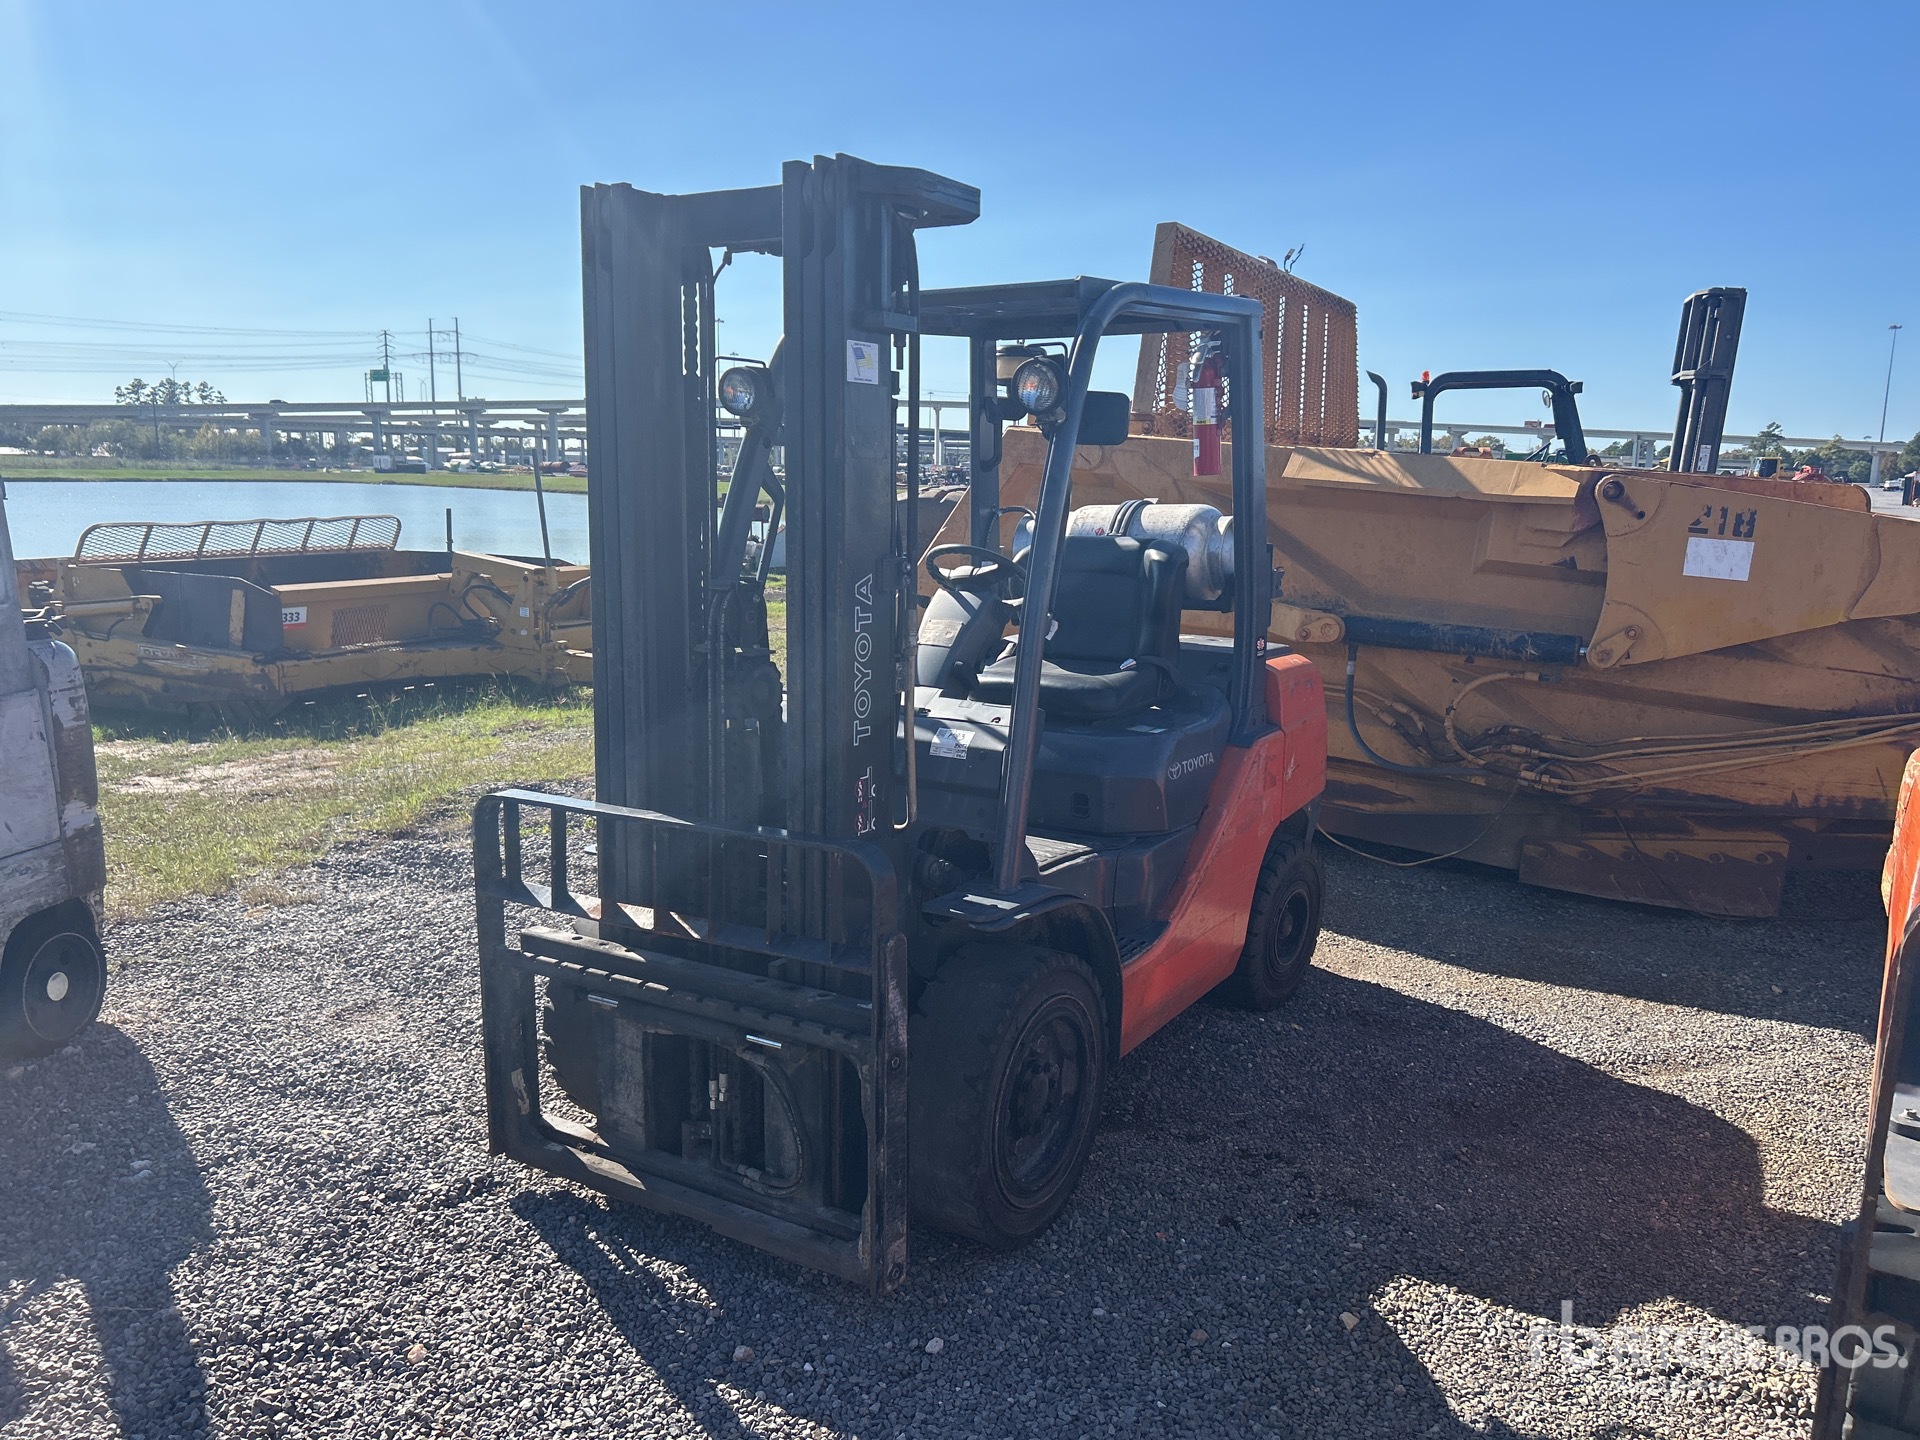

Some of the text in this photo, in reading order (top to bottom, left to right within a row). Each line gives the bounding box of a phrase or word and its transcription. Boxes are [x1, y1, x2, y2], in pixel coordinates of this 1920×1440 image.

[1687, 504, 1757, 538] 218
[853, 573, 873, 746] TOYOTA
[1182, 752, 1214, 774] TOYOTA
